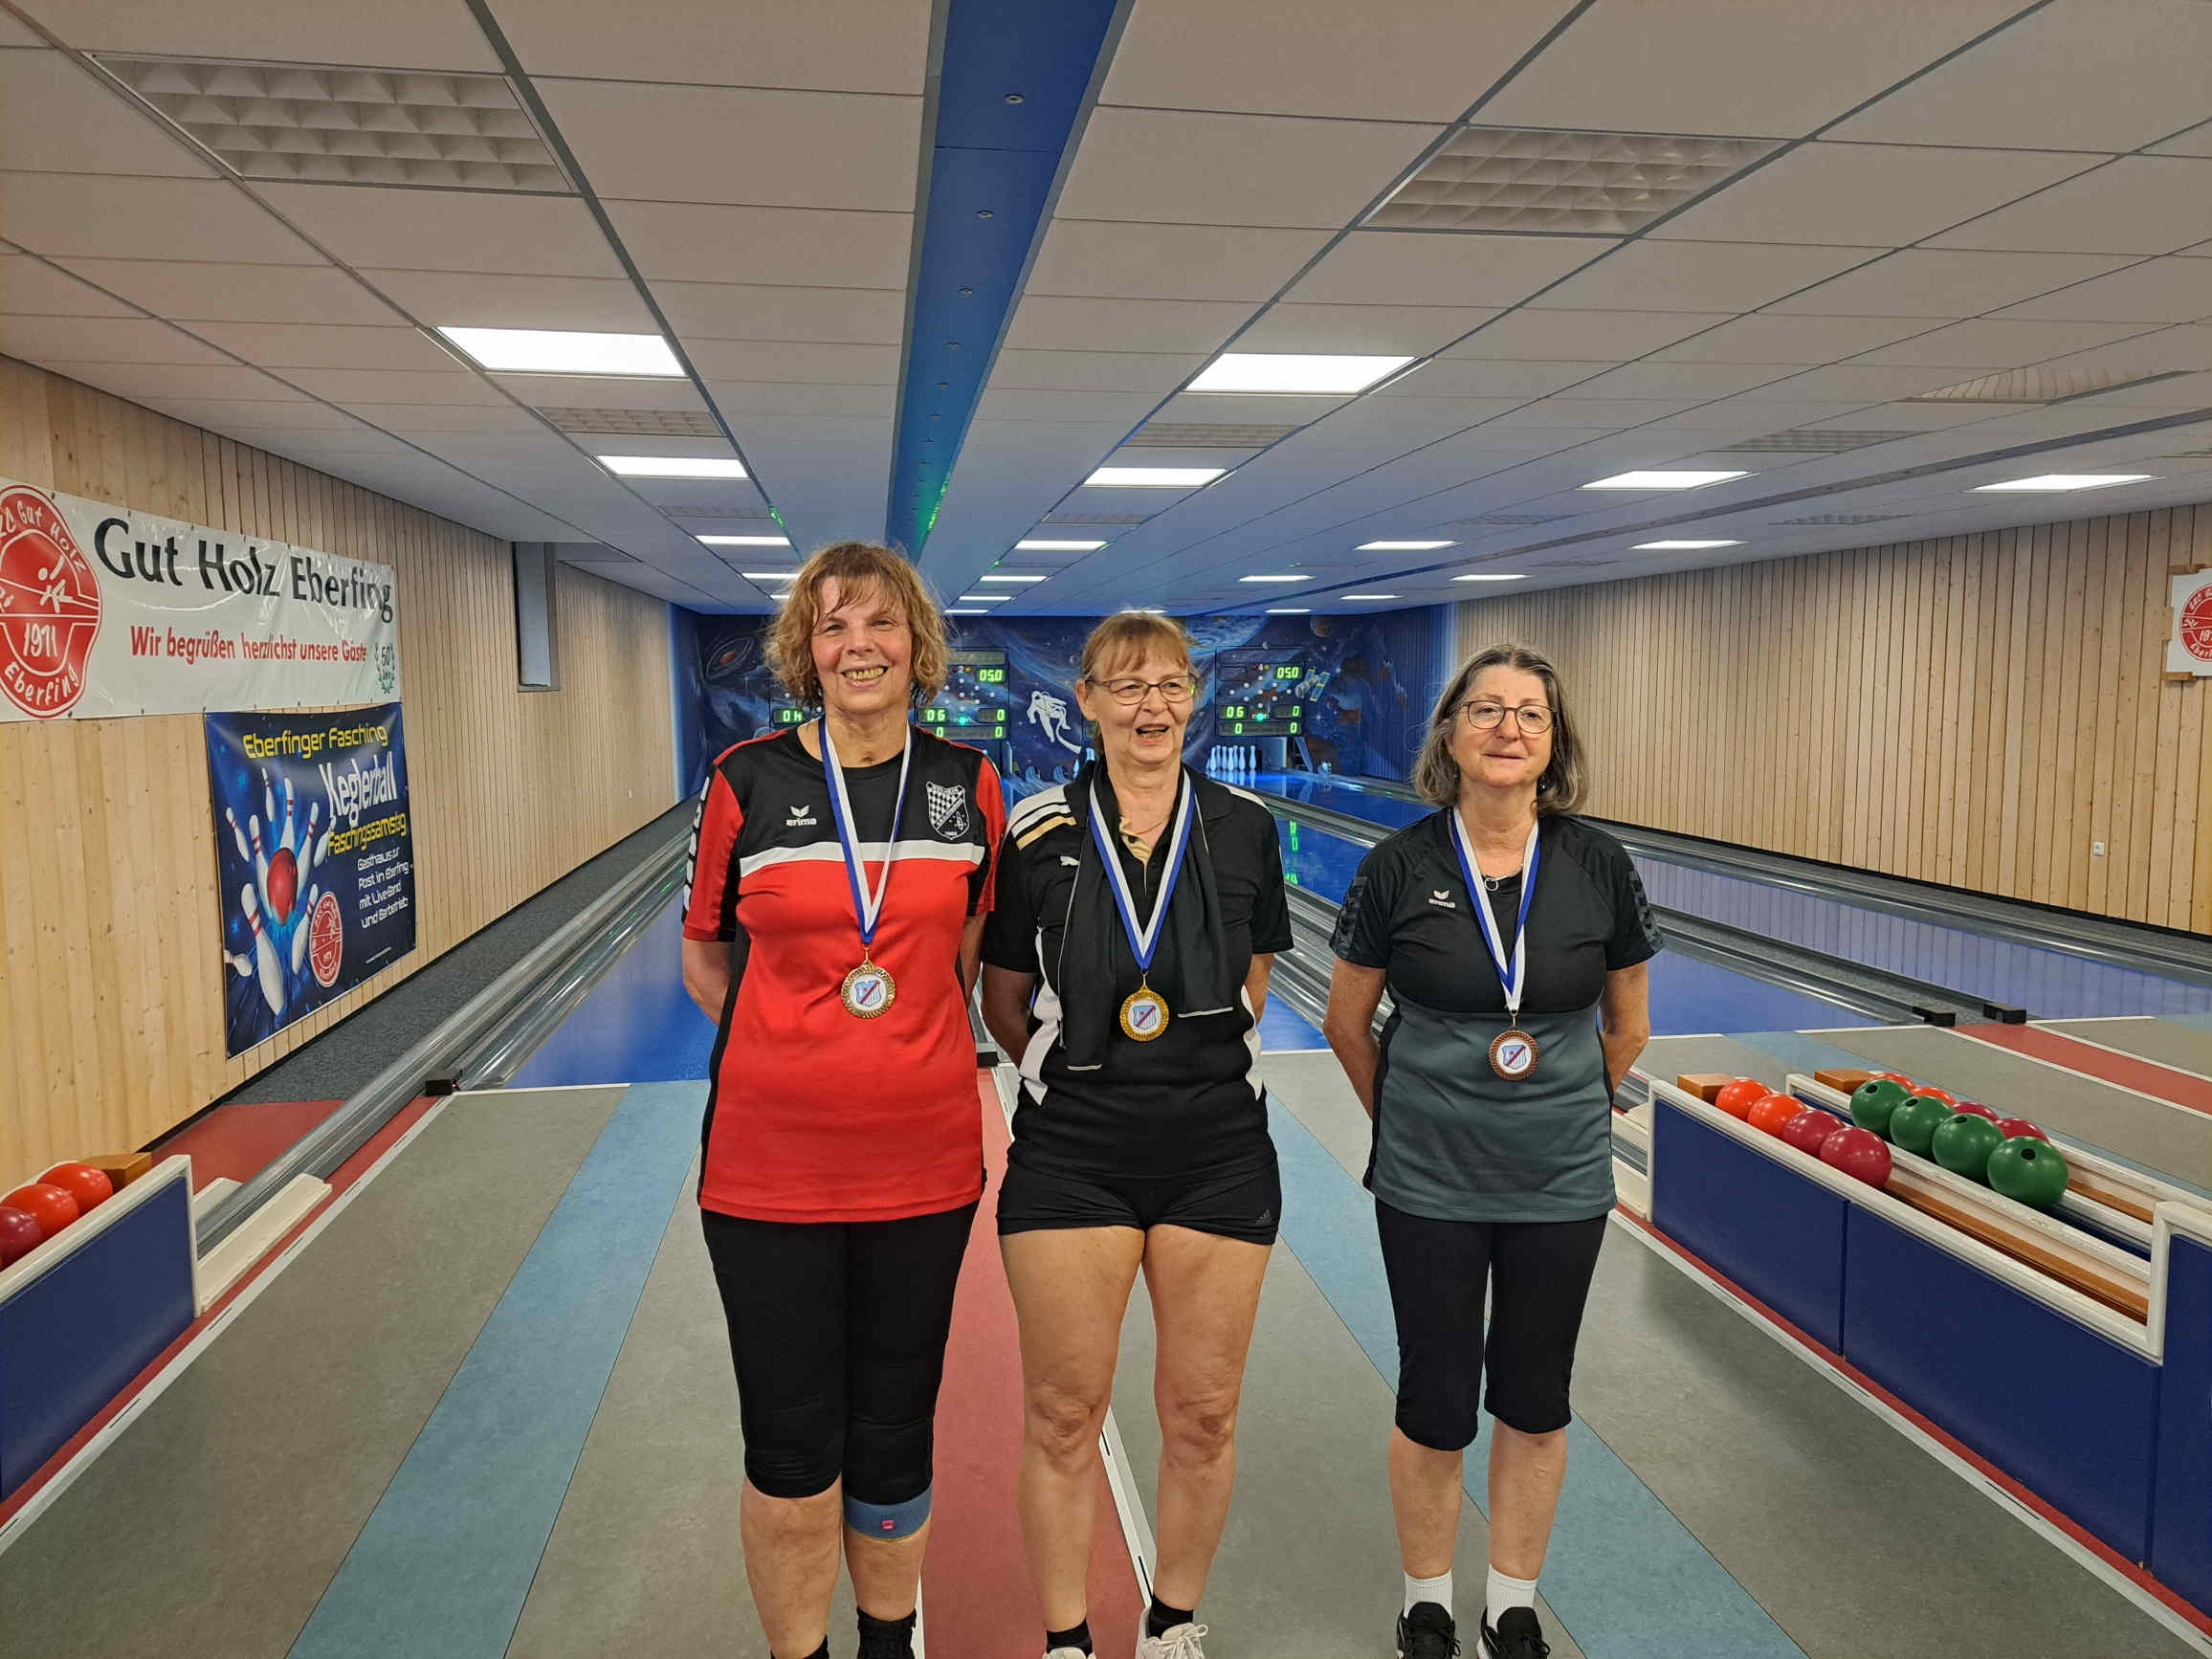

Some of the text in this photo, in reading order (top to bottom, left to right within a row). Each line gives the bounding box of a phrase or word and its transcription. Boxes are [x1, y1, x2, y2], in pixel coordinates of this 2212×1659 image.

[17, 499, 42, 527] Gut
[51, 521, 87, 573] Holz
[94, 518, 393, 623] Gut Holz Eberfing
[23, 623, 57, 658] 1971
[130, 625, 367, 665] Wir begrüßen herzlichst unsere Gäste
[979, 669, 1003, 682] 050
[1276, 666, 1299, 679] 050
[4, 661, 79, 707] Eberfing
[926, 708, 946, 722] 06
[997, 709, 1005, 721] 0
[1227, 706, 1244, 718] 06
[1293, 706, 1299, 717] 0
[995, 726, 1003, 738] 0
[1235, 723, 1242, 735] 0
[1290, 722, 1297, 734] 0
[242, 723, 388, 759] Eberfinger Fasching
[319, 750, 398, 828] Keglerball
[785, 817, 817, 827] erima
[327, 811, 407, 857] Faschingssamstag
[358, 873, 376, 891] Post
[375, 871, 386, 883] in
[359, 894, 373, 910] mit
[361, 910, 378, 929] und
